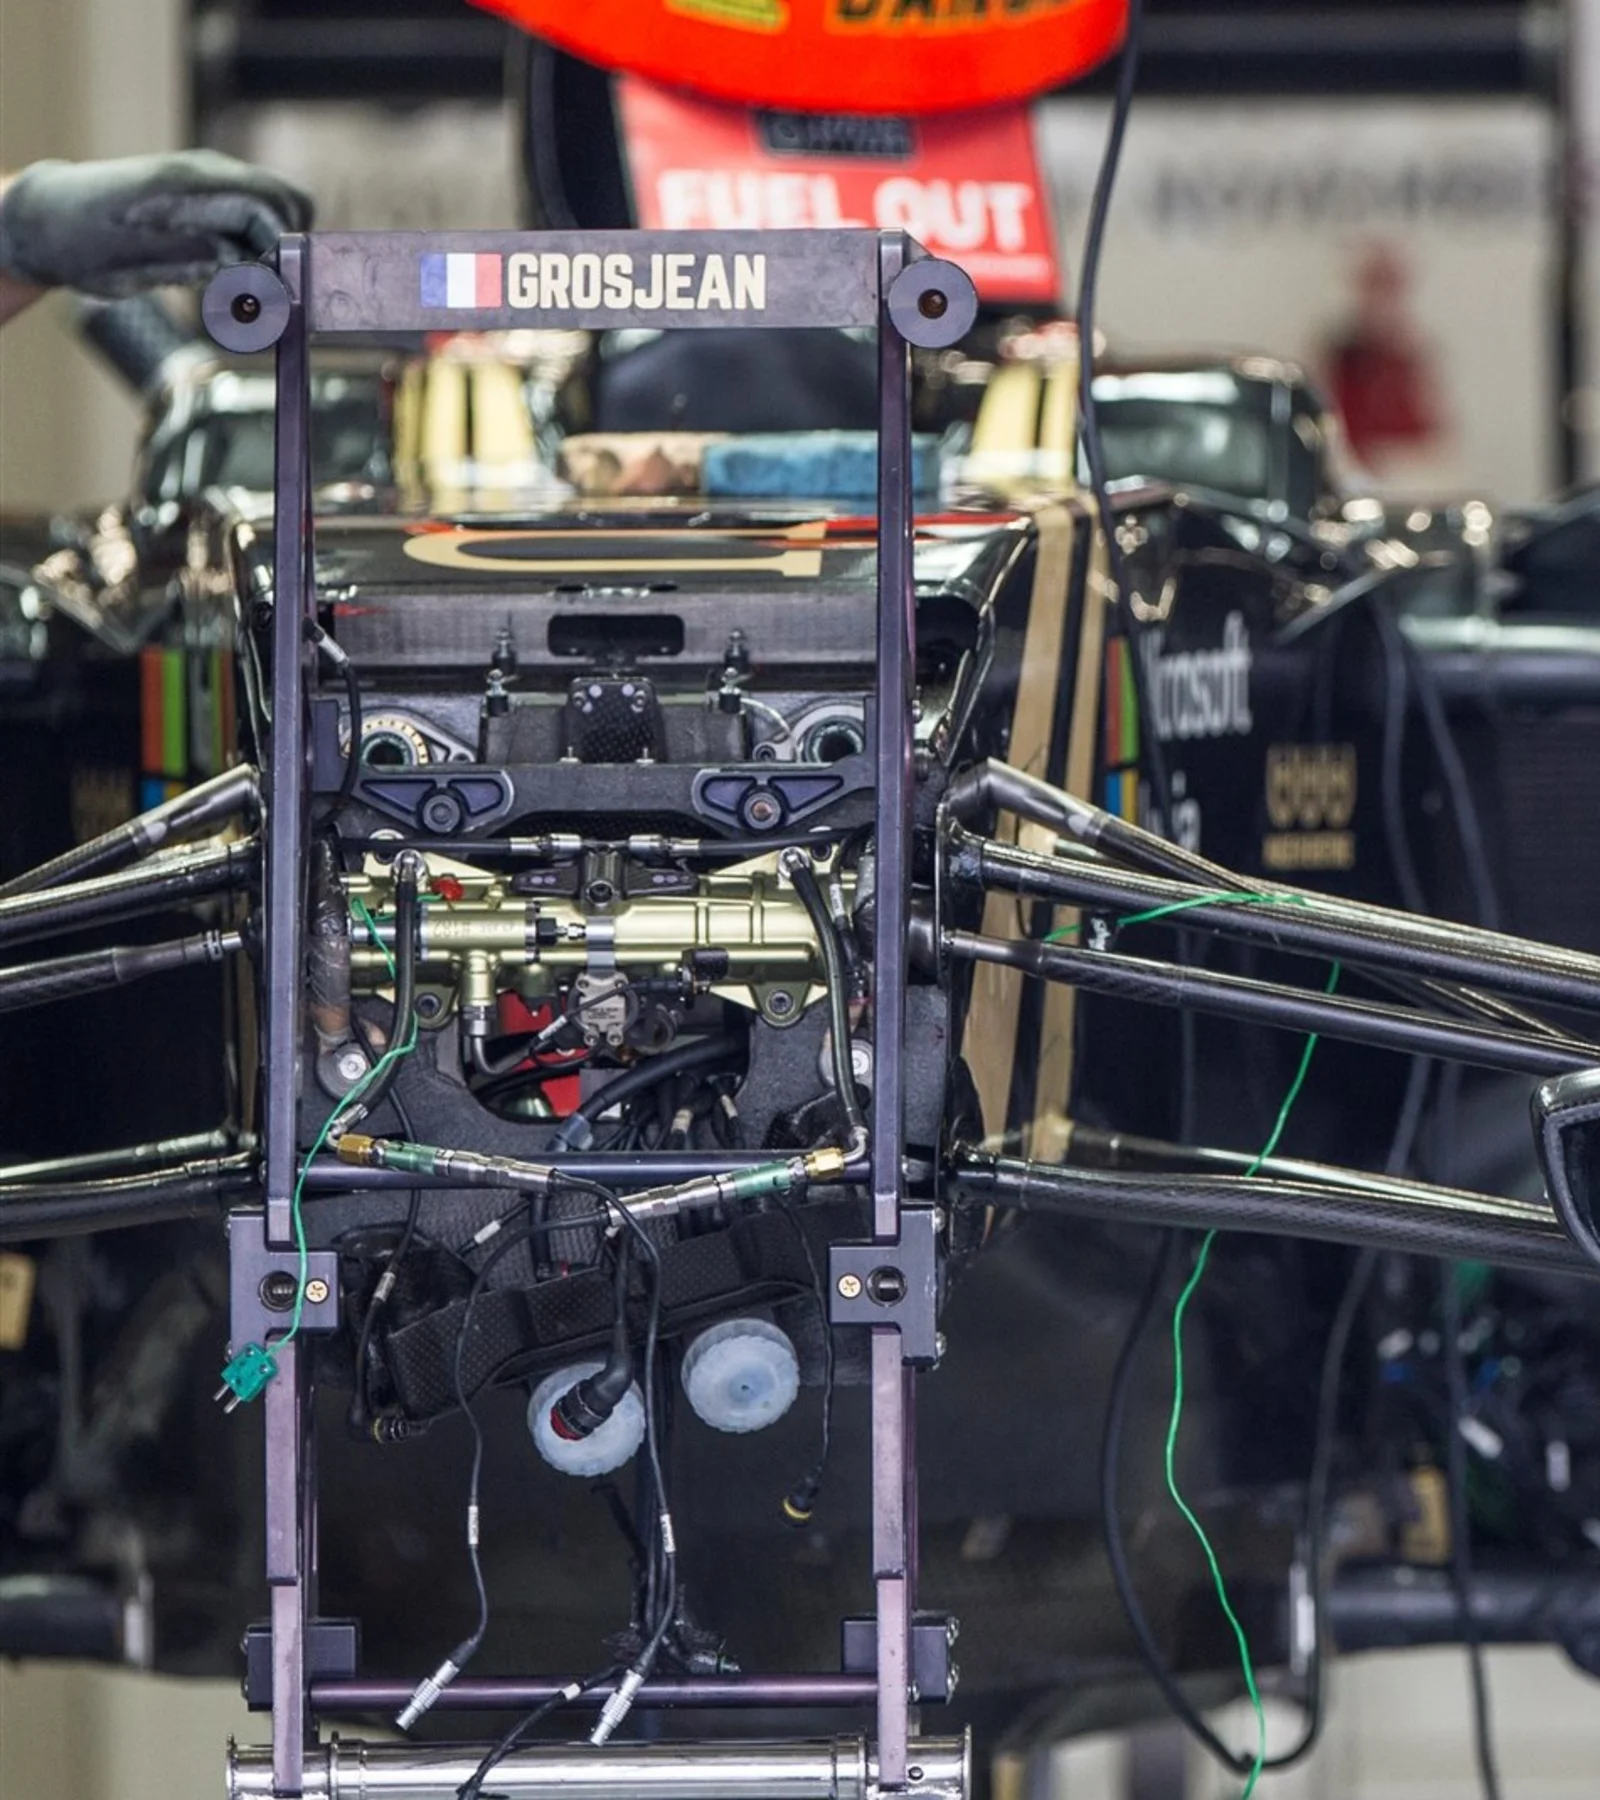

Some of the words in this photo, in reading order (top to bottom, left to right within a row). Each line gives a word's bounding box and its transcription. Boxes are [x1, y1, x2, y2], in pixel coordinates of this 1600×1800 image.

[655, 169, 870, 229] FUEL
[873, 177, 1034, 252] OUT
[508, 253, 765, 310] GROSJEAN
